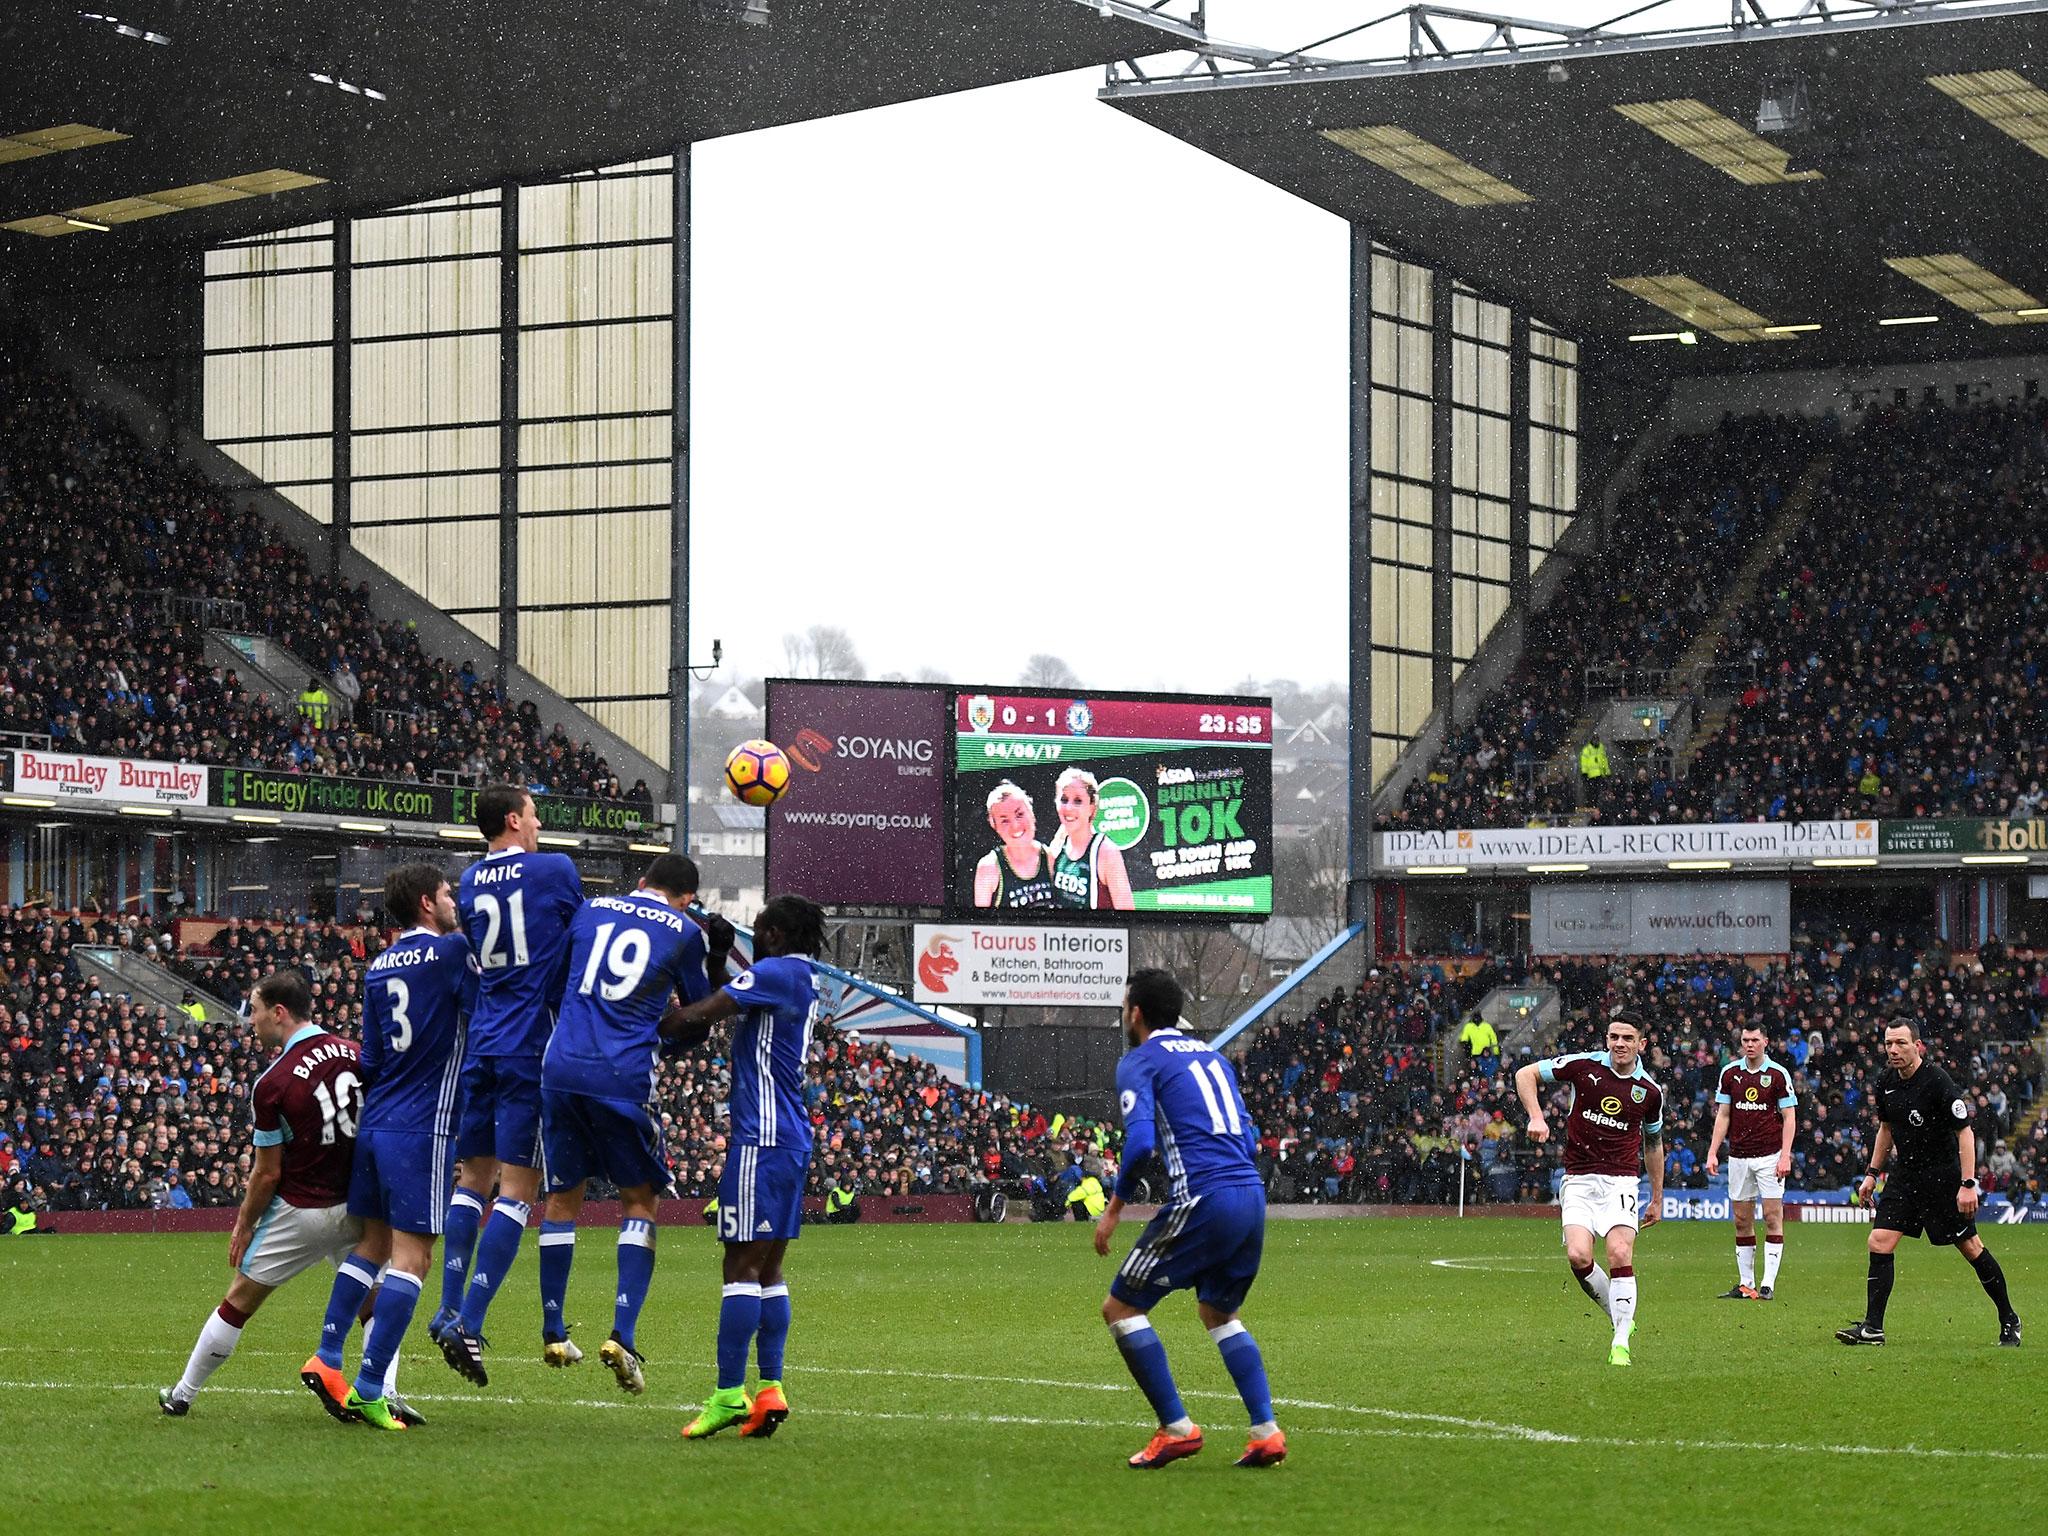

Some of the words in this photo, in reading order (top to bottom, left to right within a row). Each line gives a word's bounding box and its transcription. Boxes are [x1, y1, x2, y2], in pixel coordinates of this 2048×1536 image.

[1002, 707, 1016, 725] 0
[1046, 708, 1056, 726] 1
[1199, 713, 1262, 734] 23:35
[837, 735, 933, 761] SOYANG
[21, 754, 108, 792] Burnley
[119, 761, 202, 799] Burnley
[897, 765, 933, 777] EUROPE
[1158, 767, 1195, 785] ASDA
[59, 783, 93, 796] Express
[155, 789, 188, 802] Express
[1157, 778, 1244, 804] BURNLEY
[784, 811, 932, 830] www.soyang.co.uk
[1158, 799, 1245, 846] 10K
[1390, 831, 1454, 851] IDEAL
[1783, 822, 1852, 842] IDEAL
[1150, 849, 1177, 866] THE
[1178, 843, 1222, 863] TOWN
[1224, 839, 1257, 856] AND
[1479, 831, 1777, 857] www.IDEAL-RECRUIT.com
[1888, 839, 1925, 849] SINCE
[1930, 839, 1953, 849] 1851
[474, 863, 523, 886] MATIC
[1156, 858, 1221, 880] COUNTRY
[1224, 855, 1252, 871] 10K
[590, 897, 636, 914] DIEGO
[636, 907, 683, 932] COSTA
[1649, 911, 1772, 929] www.ucfb.com
[474, 888, 530, 969] 21
[971, 931, 1036, 951] Taurus
[1043, 932, 1123, 953] Interiors
[370, 948, 421, 971] MARCOS
[424, 946, 439, 962] A.
[578, 922, 651, 1001] 19
[991, 957, 1040, 971] Kitchen,
[1044, 958, 1103, 971] Bathroom
[971, 971, 979, 983] &
[984, 971, 1040, 983] Bedroom
[1044, 973, 1123, 985] Manufacture
[982, 989, 1111, 1001] www.taurusinteriors.co.uk
[386, 977, 412, 1052] 3
[293, 1043, 357, 1080] BARNES
[313, 1071, 364, 1145] 10
[1187, 1059, 1242, 1135] 11
[1735, 1101, 1768, 1111] dafabet
[1582, 1109, 1629, 1131] dafabet
[1620, 1194, 1637, 1216] 12
[1663, 1198, 1730, 1219] Bristol
